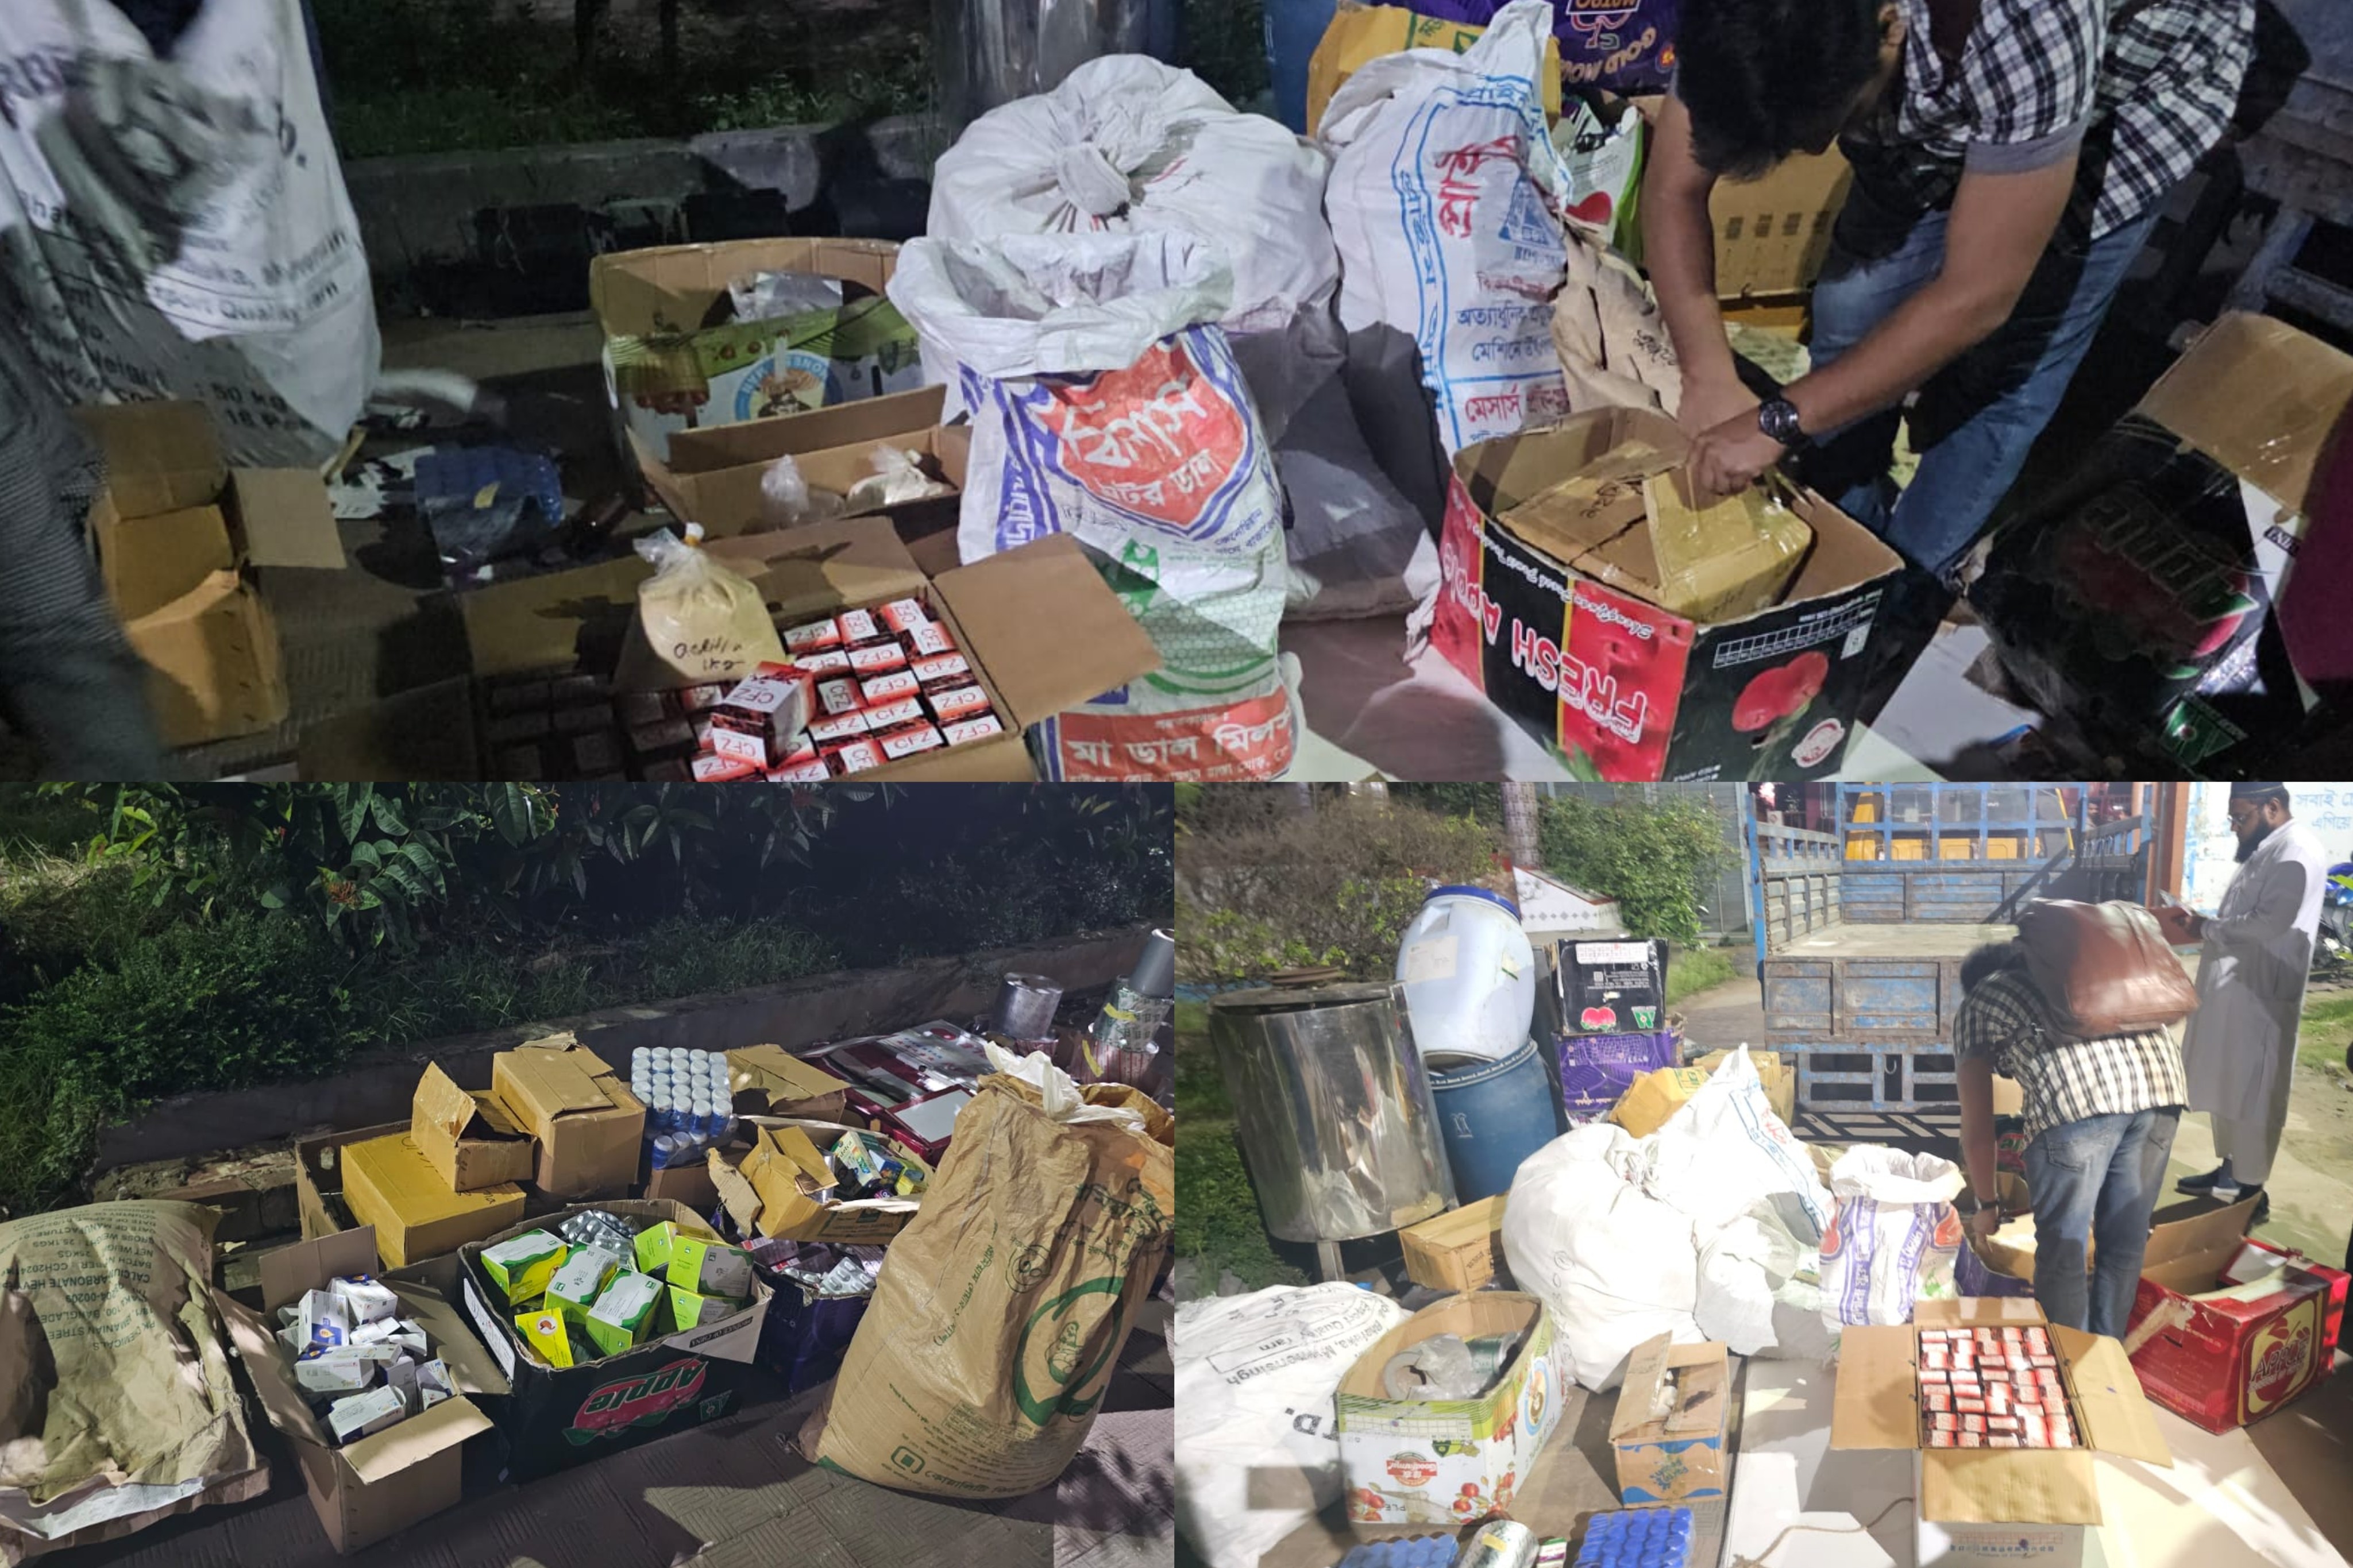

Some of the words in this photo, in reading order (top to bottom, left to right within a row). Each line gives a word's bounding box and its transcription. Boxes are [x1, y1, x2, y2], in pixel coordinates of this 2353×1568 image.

[862, 648, 894, 665] CFZ
[1511, 619, 1648, 744] FRESH
[733, 689, 774, 704] CFZ
[942, 692, 975, 709] CFZ
[875, 704, 911, 720] CFZ
[820, 717, 860, 733] CFZ
[954, 723, 990, 741] CFZ
[722, 737, 757, 757] CFZ
[894, 733, 935, 750] CFZ
[1067, 738, 1111, 767] মা
[1126, 735, 1199, 765] ডাল
[57, 1250, 90, 1258] 25KGS
[134, 1248, 154, 1258] NET
[118, 1256, 152, 1269] BATCH
